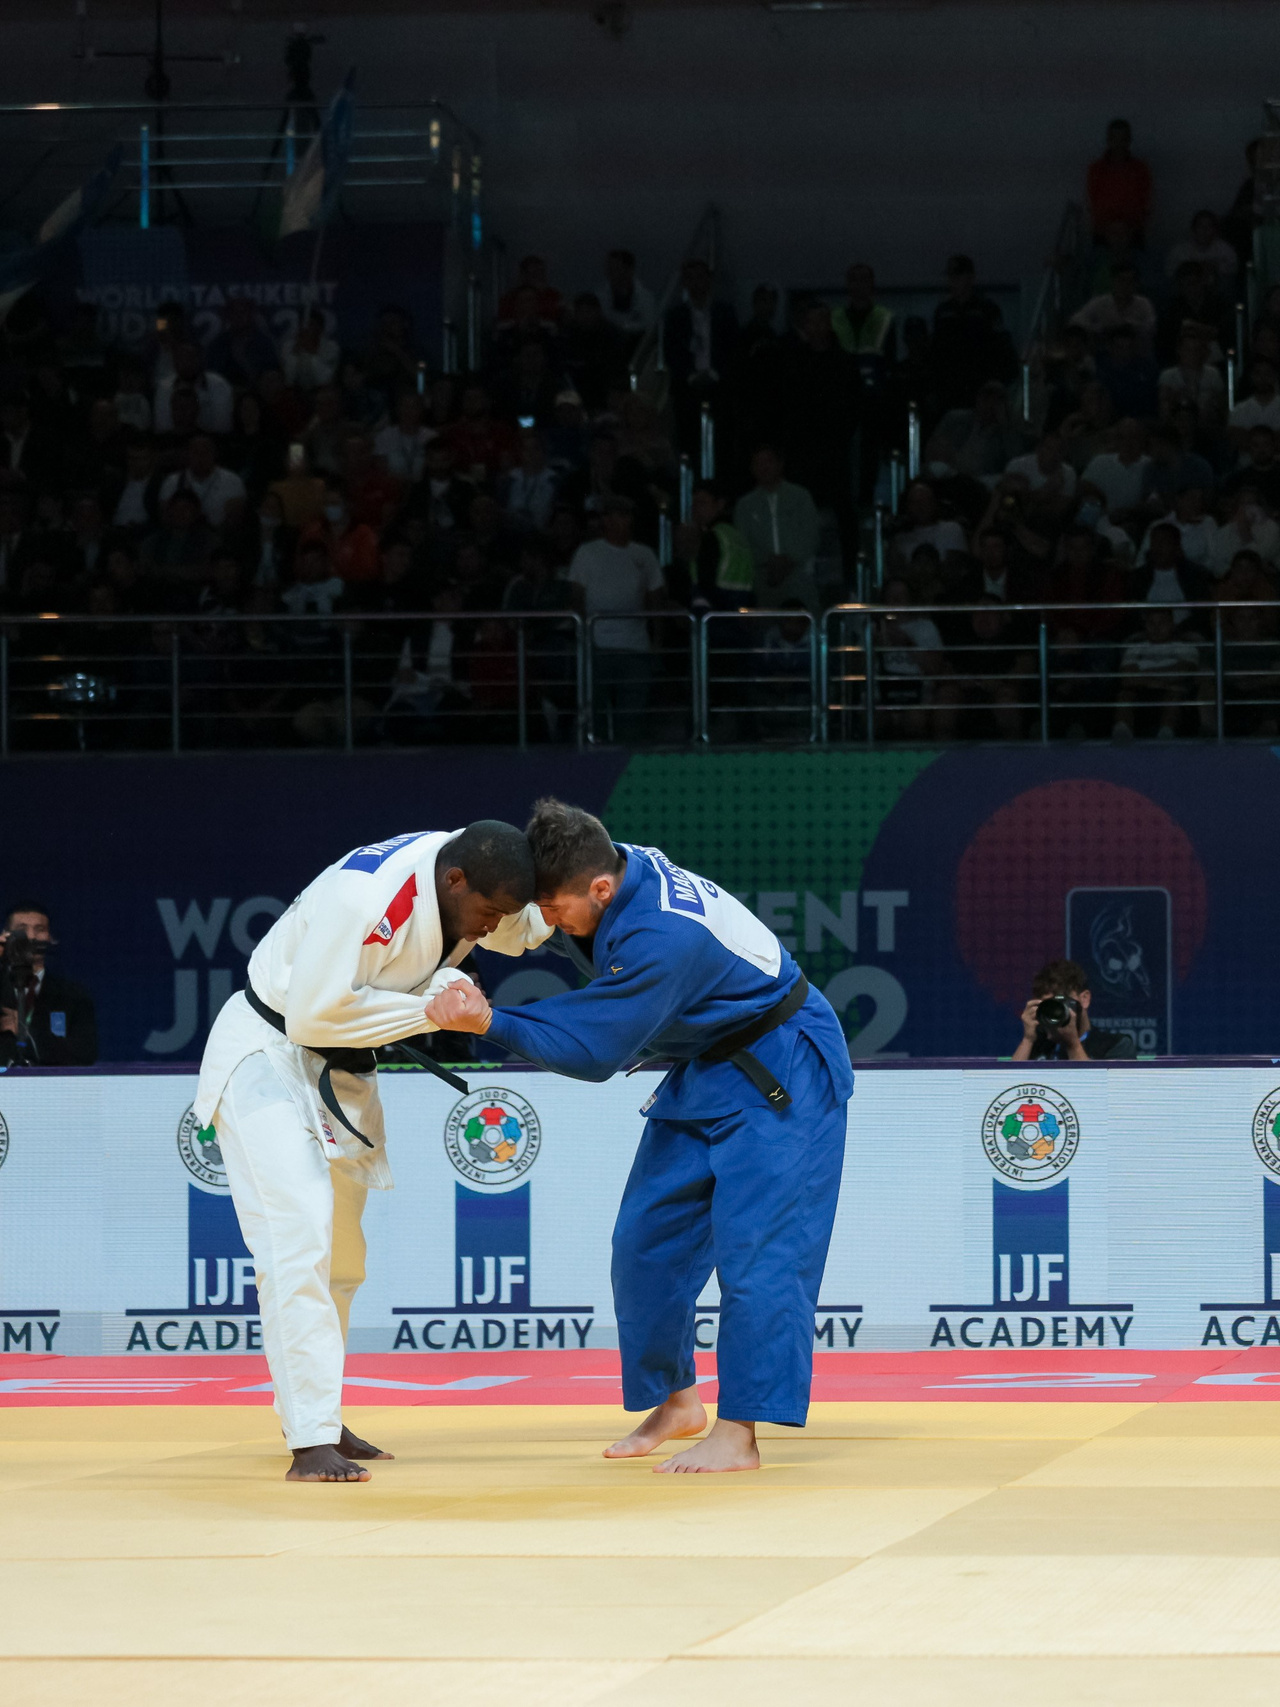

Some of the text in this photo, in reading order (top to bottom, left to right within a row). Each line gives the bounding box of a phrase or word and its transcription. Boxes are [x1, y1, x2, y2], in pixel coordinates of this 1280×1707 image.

[1090, 1018, 1157, 1029] ZBEKISTAN
[447, 1091, 537, 1181] INTERNATIONAL JUDO FEDERATION
[985, 1087, 1076, 1177] INTERNATIONAL JUDO FEDERATION
[194, 1257, 256, 1306] IJF
[460, 1256, 526, 1305] IJF
[998, 1253, 1064, 1302] IJF
[126, 1320, 263, 1351] ACADE
[392, 1318, 594, 1350] ACADEMY
[930, 1316, 1134, 1348] ACADEMY
